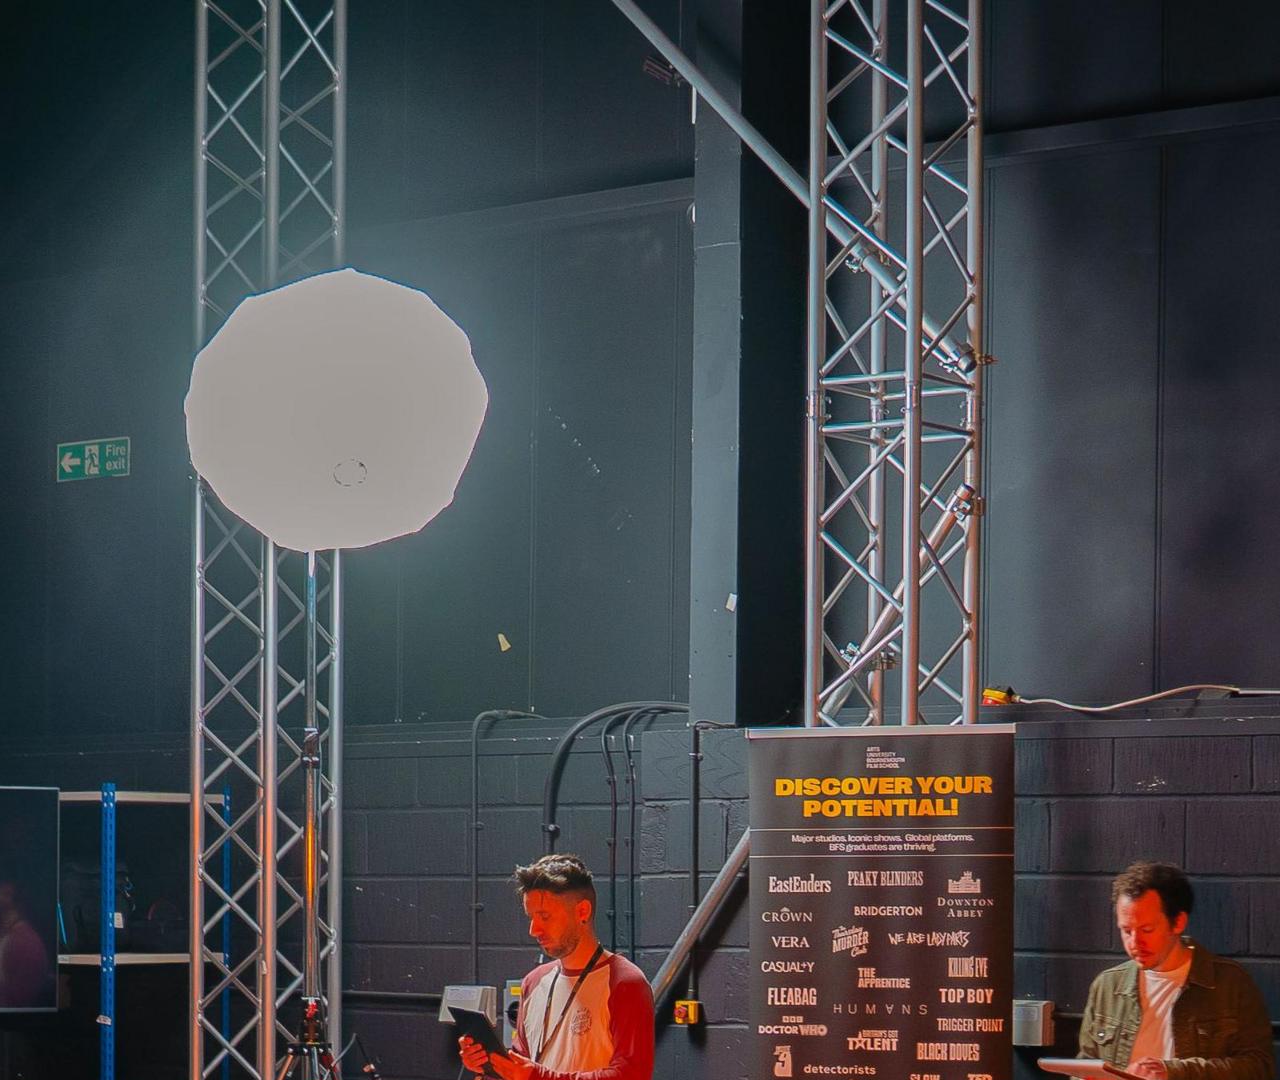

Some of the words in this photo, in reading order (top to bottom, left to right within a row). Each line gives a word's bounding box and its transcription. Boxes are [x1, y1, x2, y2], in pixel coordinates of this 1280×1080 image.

[105, 443, 127, 457] Fire
[105, 457, 126, 471] exit
[775, 777, 913, 796] DISCOVER
[916, 776, 993, 795] YOUR
[803, 799, 959, 817] POTENTIAL!
[792, 834, 813, 843] Major
[815, 834, 847, 842] studios.
[848, 834, 872, 842] Iconic
[874, 834, 903, 842] shows.
[905, 833, 932, 842] Global
[932, 832, 975, 843] platforms.
[846, 843, 887, 853] graduates
[888, 843, 902, 851] are
[903, 842, 936, 852] thriving.
[769, 873, 832, 893] EastEnders
[847, 870, 879, 886] PEAKY
[880, 870, 924, 887] BLINDERS
[937, 897, 994, 907] DOWNTON
[761, 911, 813, 922] CROWN
[854, 906, 923, 916] BRIDGERTON
[947, 908, 984, 918] ABBEY
[771, 936, 810, 948] VERA
[832, 931, 869, 953] MURDER
[888, 932, 905, 945] WE
[906, 931, 926, 944] ARE
[858, 967, 876, 978] THE
[948, 956, 974, 977] KILLING
[975, 957, 988, 977] EVE
[858, 978, 910, 988] APPRENTICE
[767, 987, 817, 1005] FLEABAG
[939, 988, 964, 1003] TOP
[966, 988, 994, 1003] BOY
[758, 1025, 799, 1034] DOCTOR
[799, 1024, 828, 1036] WHO
[936, 1018, 974, 1031] TRIGGER
[975, 1018, 1004, 1032] POINT
[917, 1042, 947, 1061] BLACK
[948, 1043, 980, 1061] DOVES
[803, 1064, 877, 1075] detectorists
